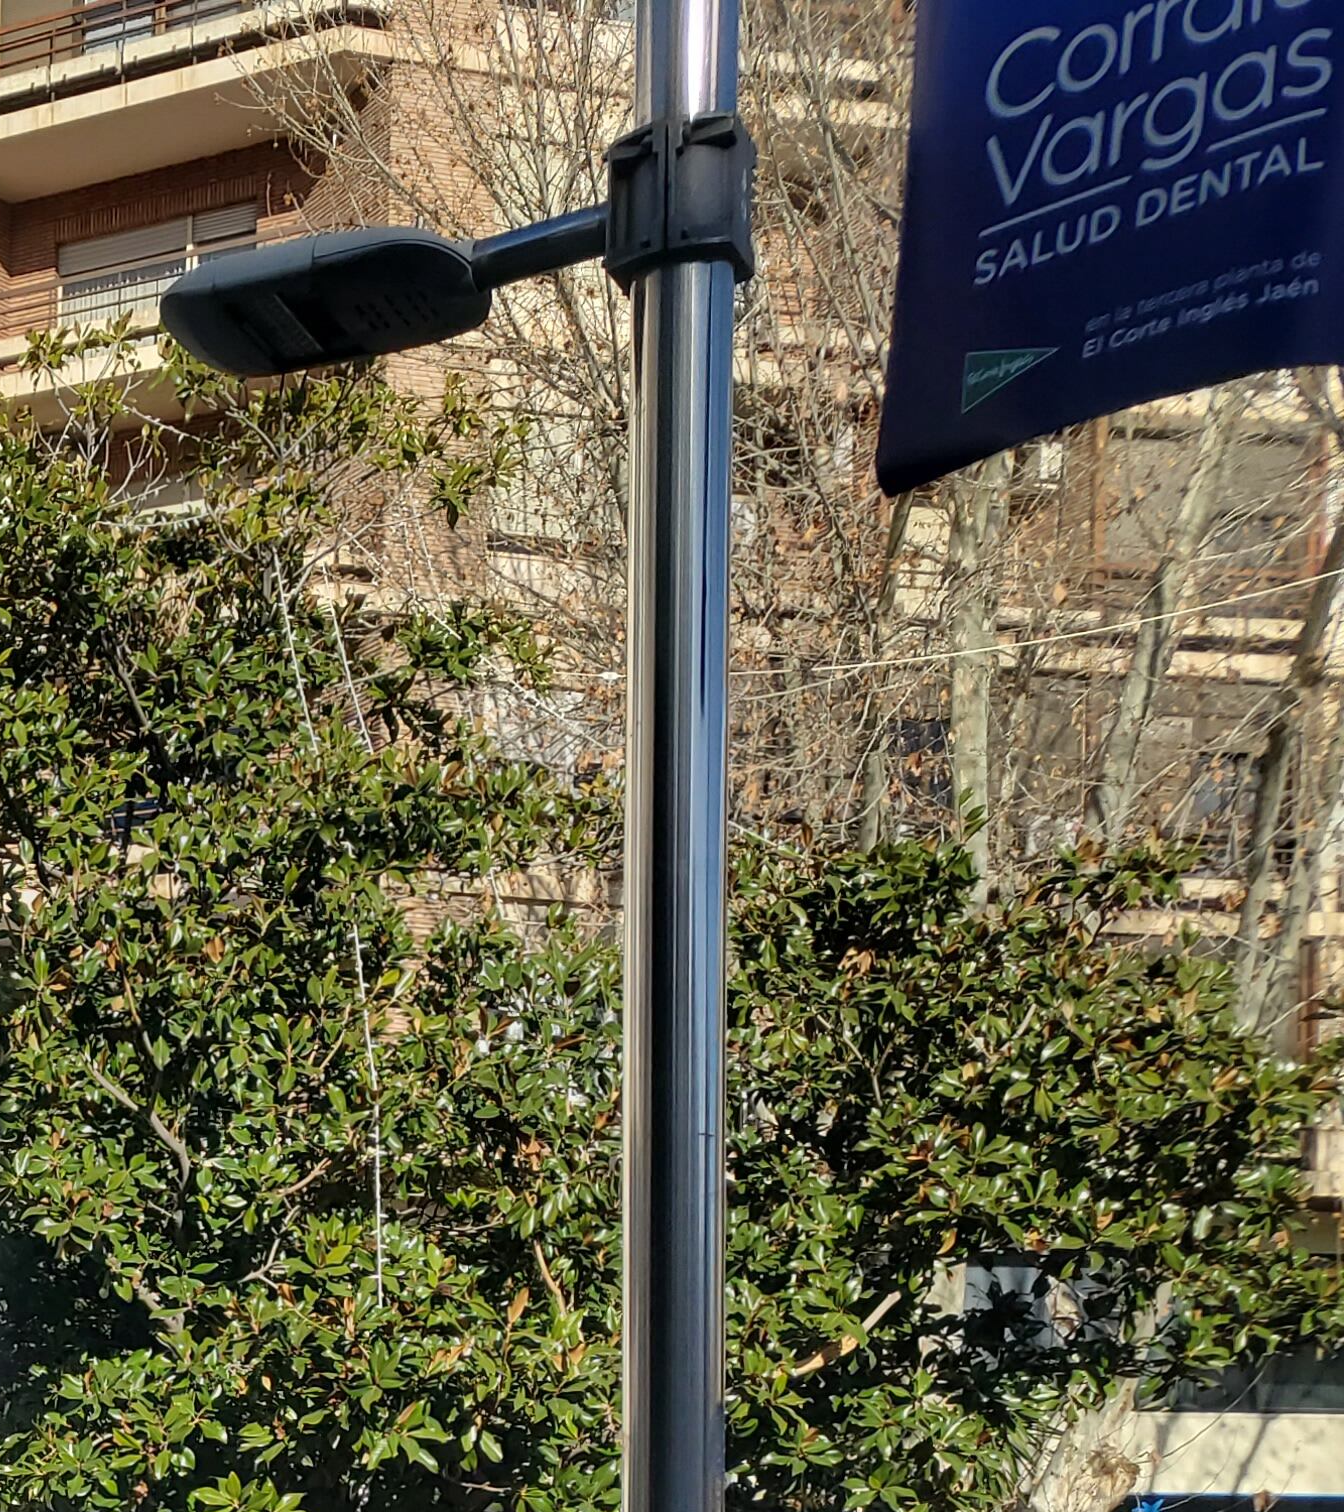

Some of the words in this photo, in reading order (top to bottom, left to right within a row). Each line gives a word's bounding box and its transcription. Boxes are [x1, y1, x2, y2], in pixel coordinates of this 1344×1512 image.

[985, 28, 1332, 206] Vargas
[973, 204, 1121, 287] SALUD
[1135, 137, 1325, 229] DENTAL
[1290, 249, 1322, 269] de
[1081, 339, 1104, 359] El
[1108, 317, 1171, 349] Corte
[1176, 291, 1250, 326] Inglés
[1255, 278, 1320, 303] Jaén
